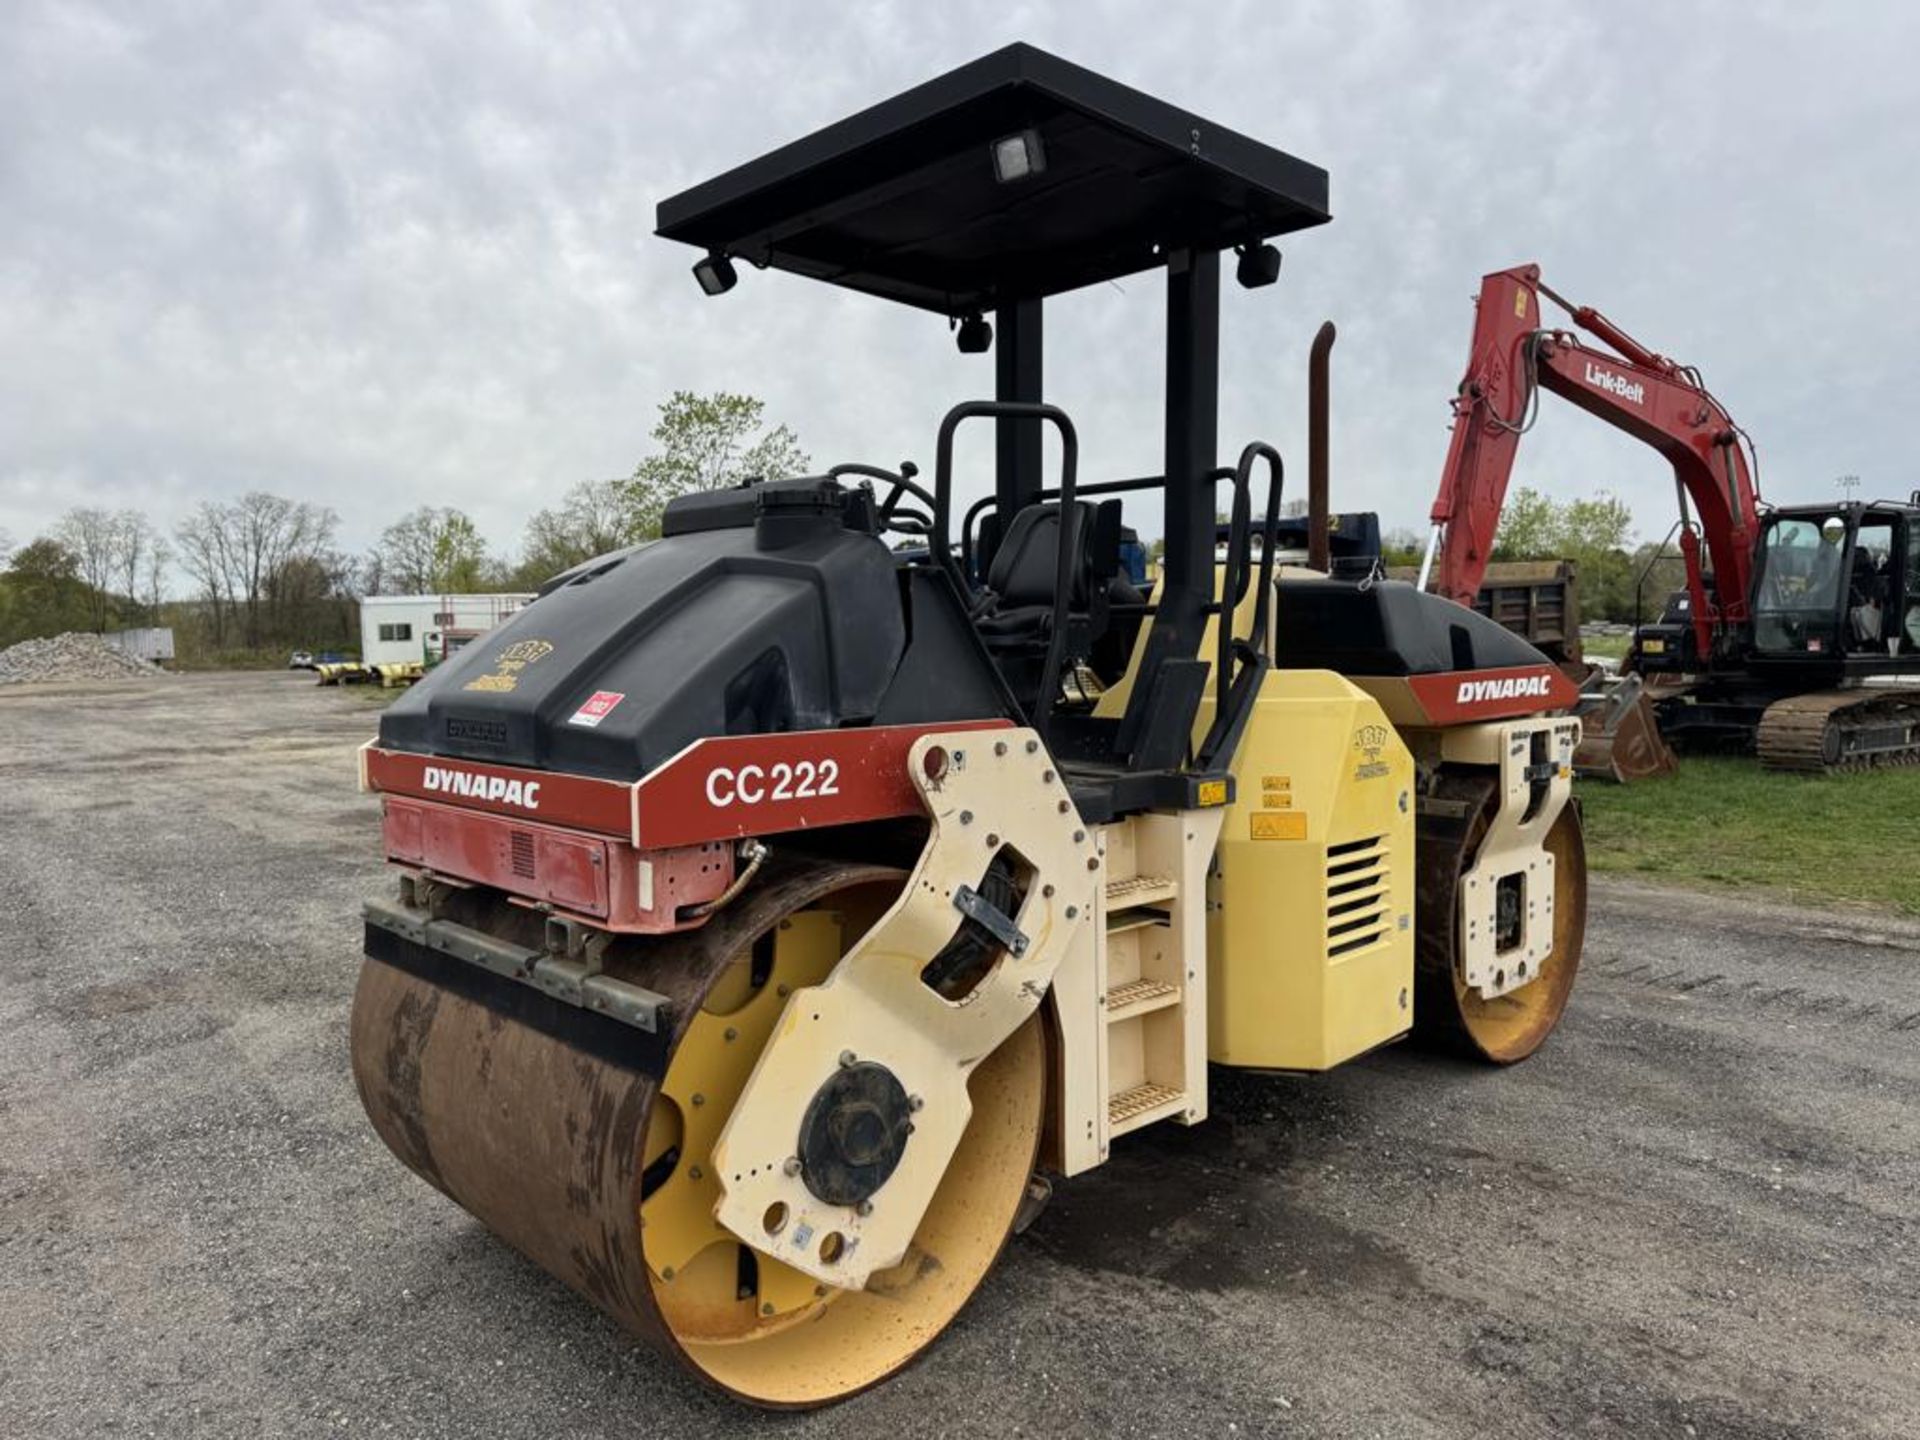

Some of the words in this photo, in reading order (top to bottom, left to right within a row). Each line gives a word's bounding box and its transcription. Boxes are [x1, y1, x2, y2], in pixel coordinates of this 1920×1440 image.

[1585, 362, 1644, 405] Link-Belt
[1456, 674, 1552, 704] DYNAPAC
[423, 766, 541, 809] DYNAPAC
